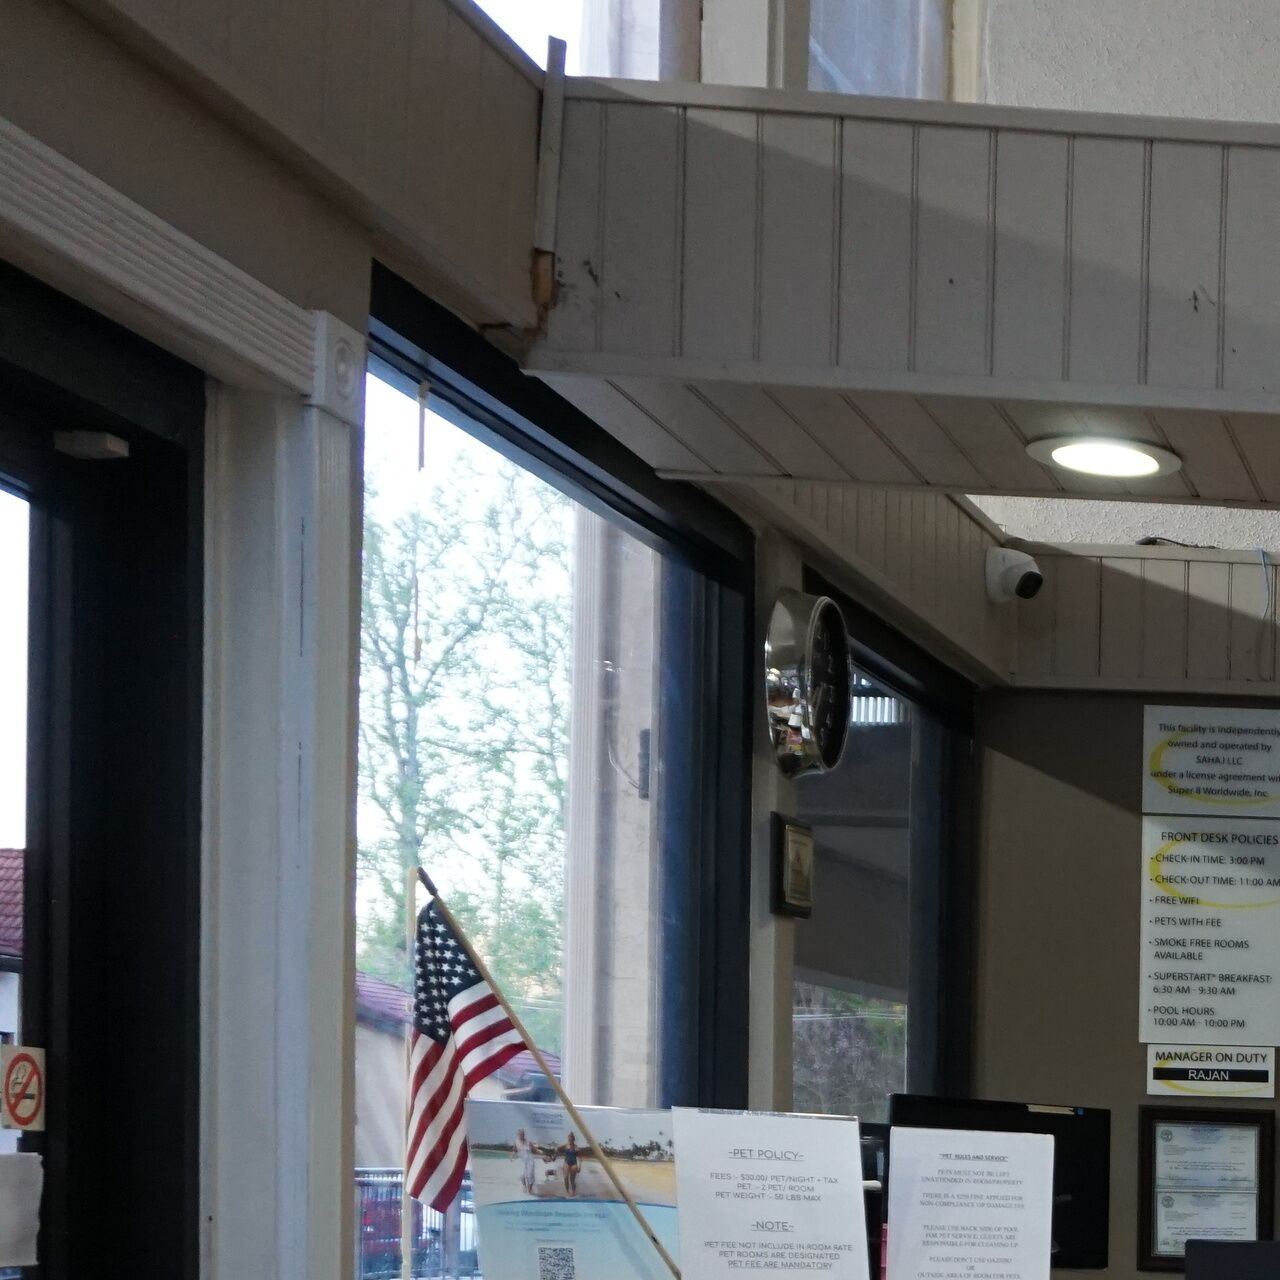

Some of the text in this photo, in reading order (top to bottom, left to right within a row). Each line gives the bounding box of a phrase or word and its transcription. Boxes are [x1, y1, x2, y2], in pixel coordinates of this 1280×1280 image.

[1159, 723, 1175, 731] This
[1201, 741, 1216, 749] and
[1219, 742, 1259, 751] operated
[1262, 743, 1271, 753] by
[1227, 757, 1243, 765] LLC
[1151, 771, 1176, 779] under
[1186, 771, 1216, 780] license
[1219, 773, 1265, 783] agreement
[1168, 785, 1193, 795] Super
[1161, 832, 1279, 845] FRONT DESK POLICIES
[1155, 854, 1200, 864] CHECK-IN
[1229, 856, 1248, 865] 3:00
[1251, 857, 1265, 865] PM
[1155, 875, 1210, 885] CHECK-OUT
[1240, 877, 1264, 886] 11:00
[1266, 878, 1280, 887] AM
[1155, 896, 1199, 905] FREE WIFI
[1154, 917, 1222, 927] PETS WITH FEE
[1154, 938, 1249, 949] SMOKE FREE ROOMS
[1154, 952, 1203, 961] AVAILABLE
[1153, 985, 1172, 994] 6:30
[1175, 986, 1190, 994] AM
[1198, 986, 1218, 995] 9:30
[1220, 987, 1235, 995] AM
[1154, 1006, 1215, 1016] POOL HOURS
[1154, 1018, 1245, 1028] 10:00 AM 10:00 PM
[1155, 1051, 1267, 1063] MANAGER ON DUTY
[1188, 1070, 1229, 1080] RAJAN
